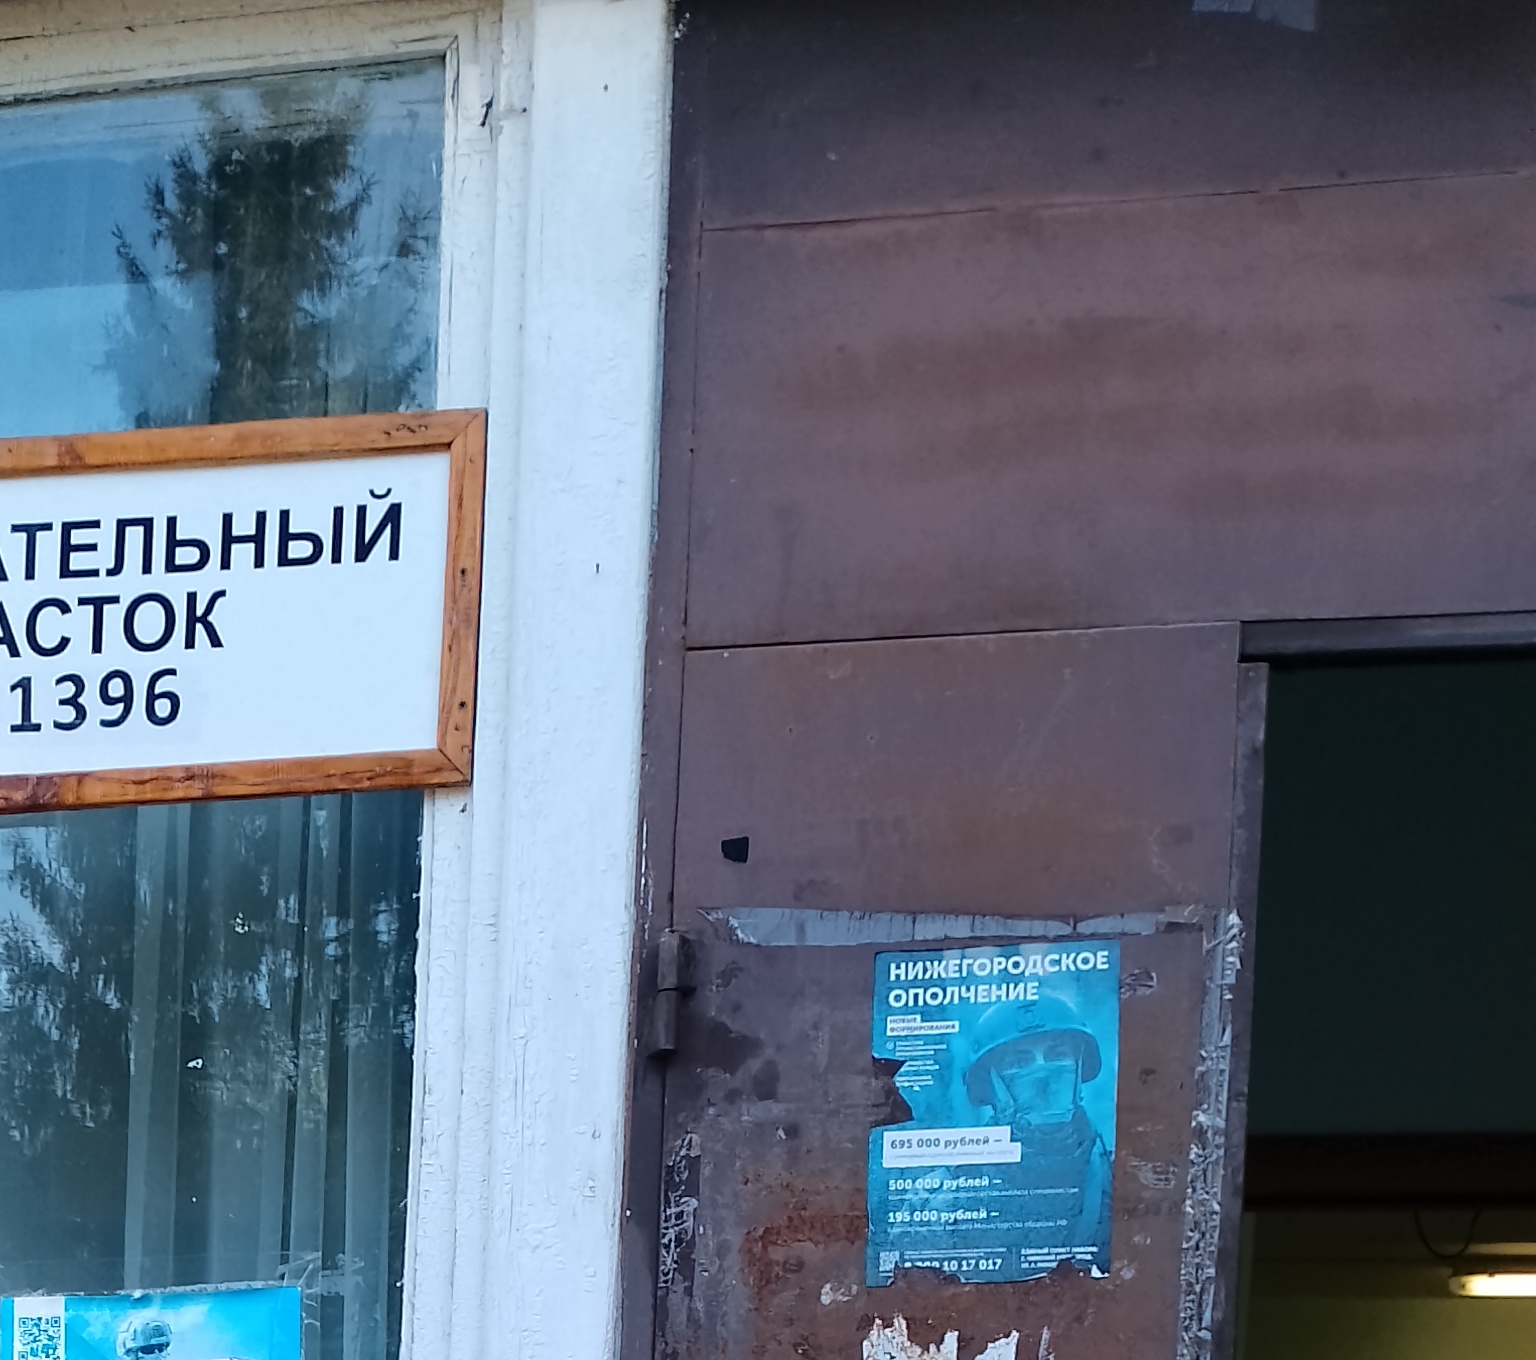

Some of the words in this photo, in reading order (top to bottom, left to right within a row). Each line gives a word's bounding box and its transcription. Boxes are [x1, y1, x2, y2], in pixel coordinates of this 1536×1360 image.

[8, 668, 181, 734] 1396
[888, 950, 1110, 983] НИЖЕГОРОДСКОЕ
[888, 982, 1040, 1008] ОПОЛЧЕНИЕ
[890, 1138, 913, 1150] 695
[917, 1137, 941, 1148] 000
[944, 1134, 989, 1150] рублей
[888, 1180, 913, 1191] 500
[915, 1178, 940, 1189] 000
[943, 1174, 989, 1191] рублей
[888, 1211, 910, 1223] 195
[913, 1210, 938, 1222] 000
[940, 1206, 987, 1223] рублей
[942, 1260, 958, 1272] 10
[962, 1259, 976, 1271] 17
[979, 1258, 1003, 1271] 017
